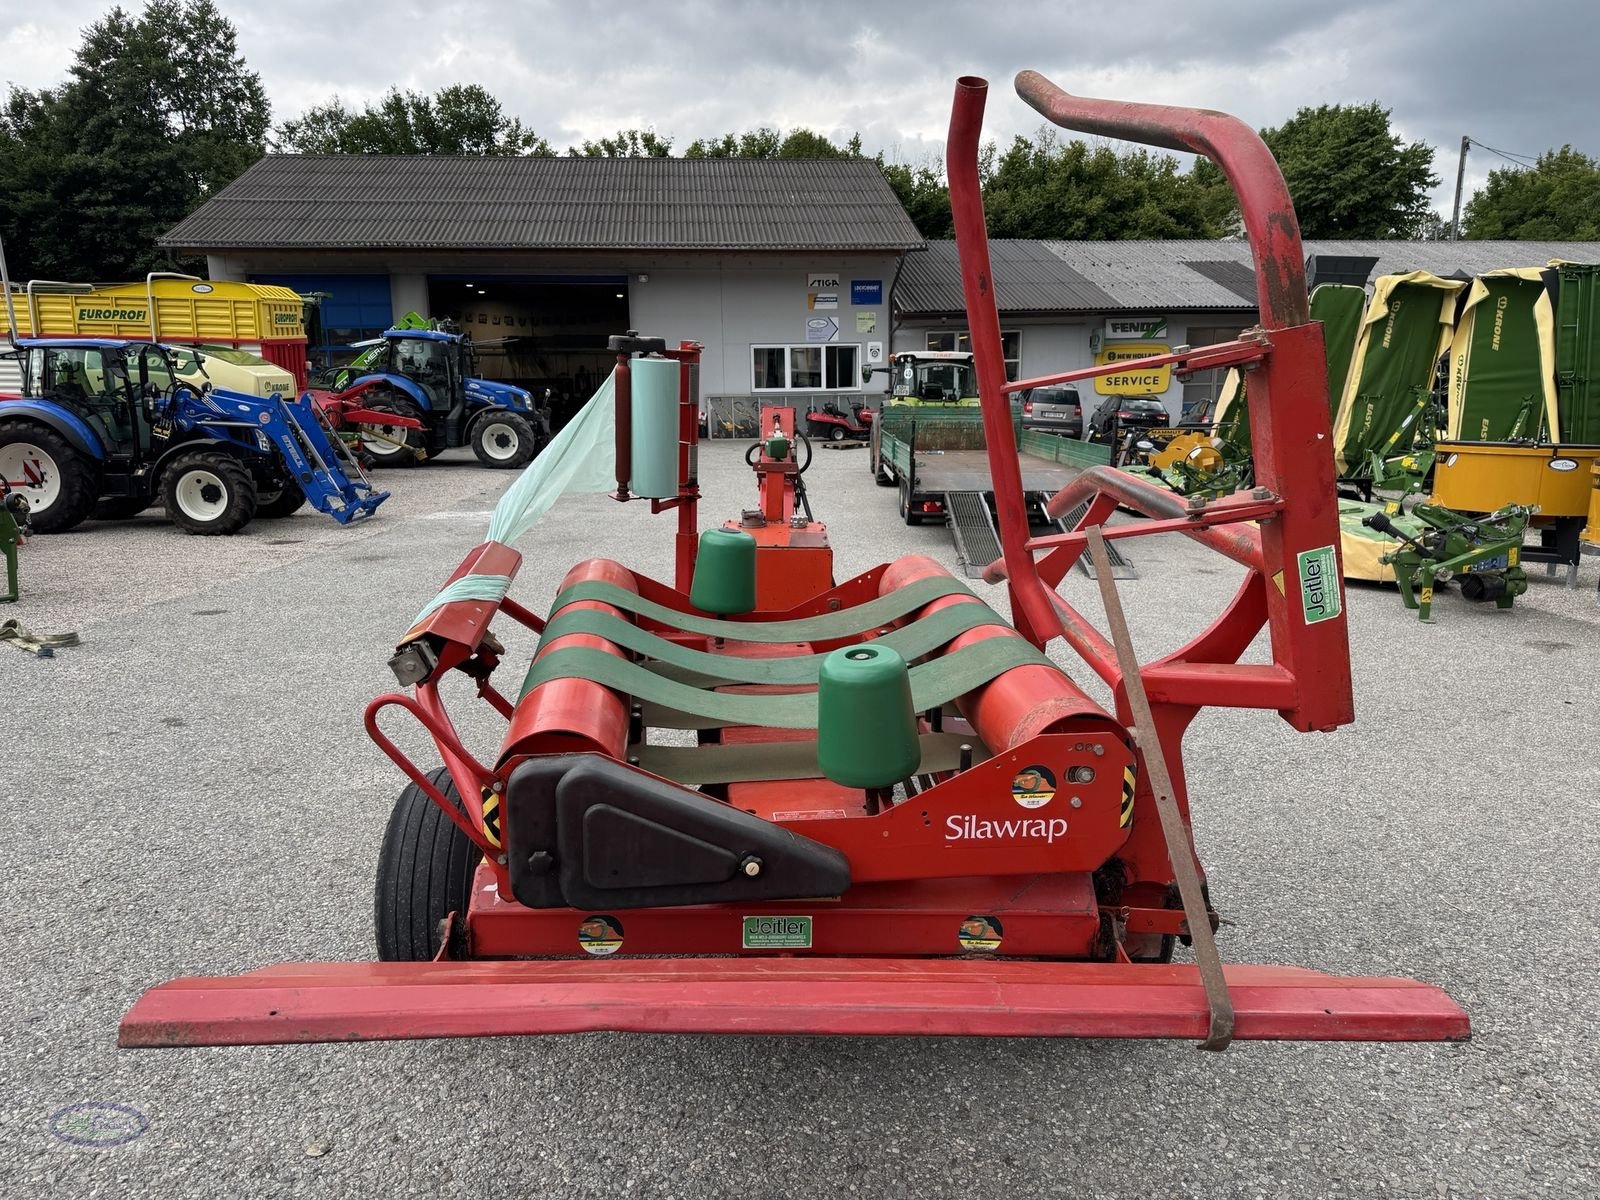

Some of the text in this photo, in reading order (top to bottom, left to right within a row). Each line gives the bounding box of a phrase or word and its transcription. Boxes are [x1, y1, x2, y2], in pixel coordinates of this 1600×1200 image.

[810, 279, 839, 287] STIGA
[78, 308, 147, 322] EUROPROFI
[275, 312, 298, 324] EUROPROFI
[1382, 312, 1397, 349] KRONE
[1492, 308, 1504, 351] KRONE
[363, 342, 388, 365] MERL
[1132, 352, 1161, 360] HOLLA
[272, 383, 290, 391] KRONE
[1105, 376, 1160, 386] SERVICE
[1304, 557, 1325, 615] Jeitler
[945, 814, 1068, 844] Silawrap
[749, 918, 806, 934] Jeitler
